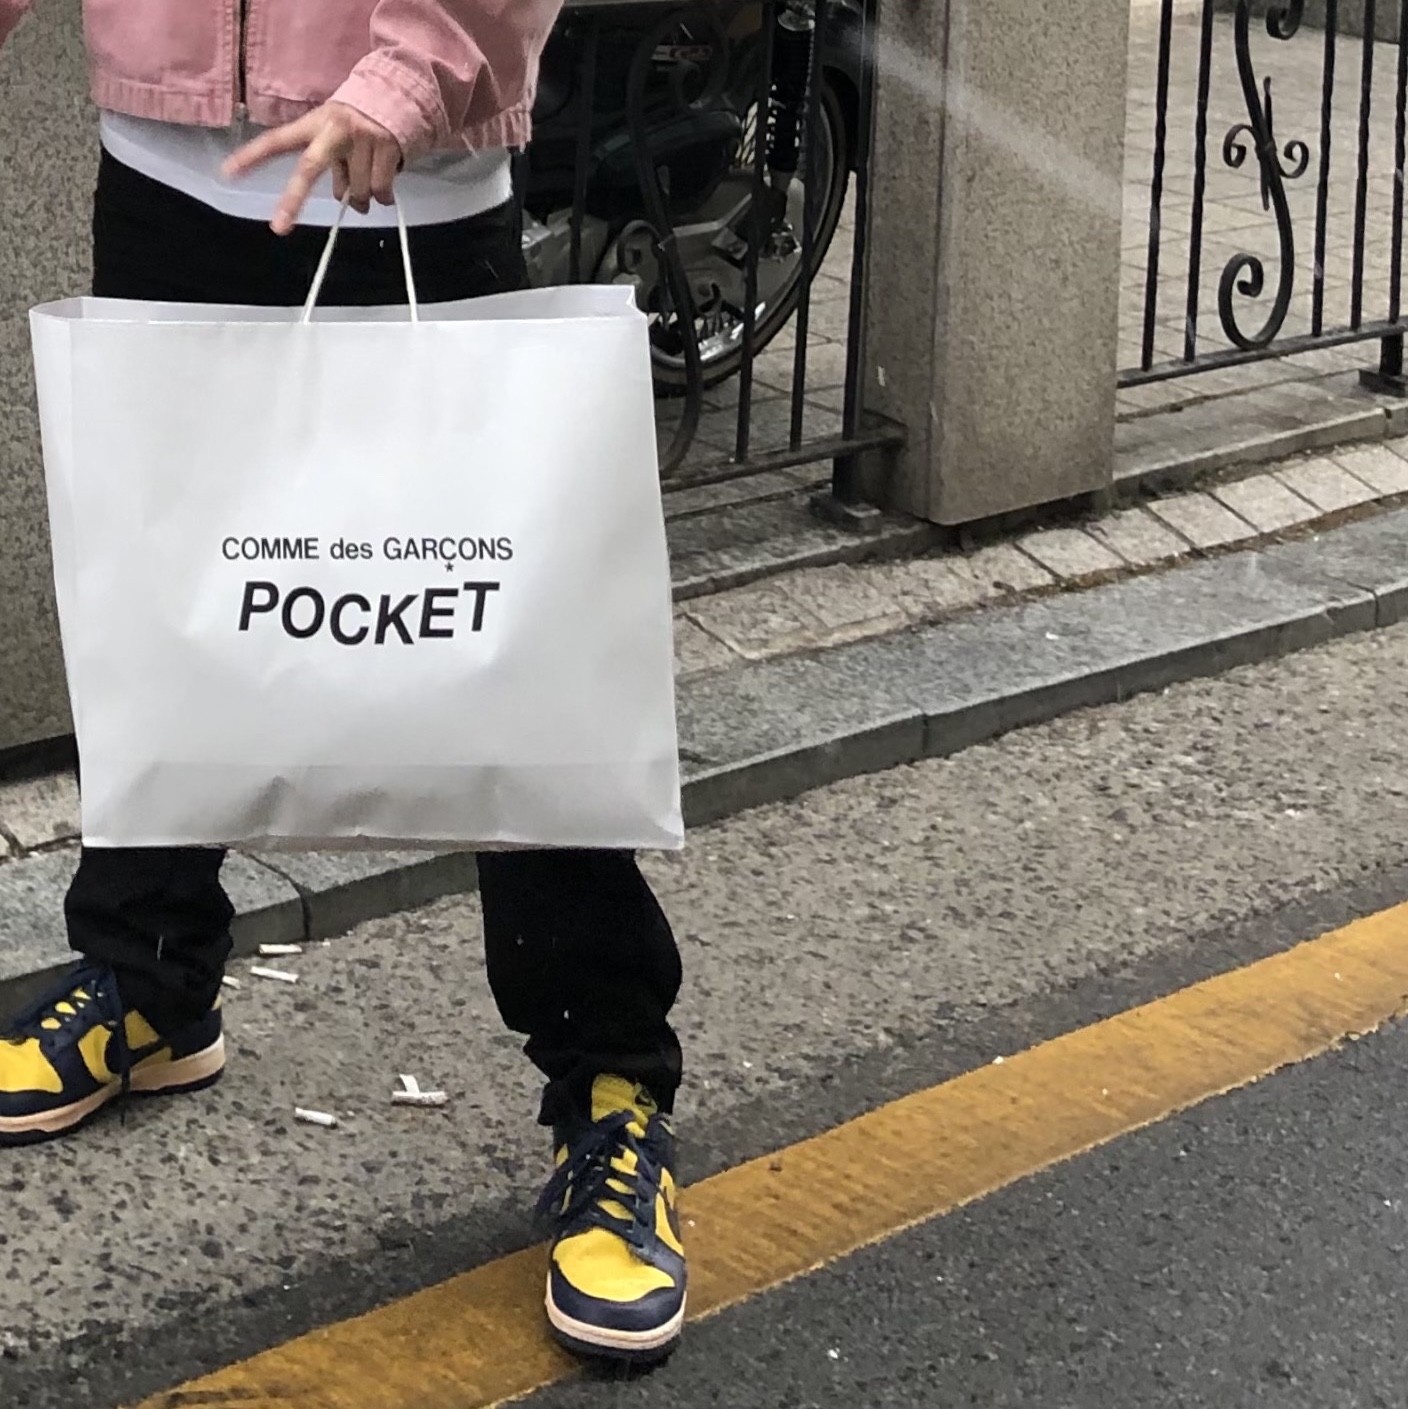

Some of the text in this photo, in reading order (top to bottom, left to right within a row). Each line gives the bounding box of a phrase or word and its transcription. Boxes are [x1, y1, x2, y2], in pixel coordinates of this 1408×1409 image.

[221, 536, 513, 571] COMME des GARÇONS
[238, 580, 501, 645] POCKET
